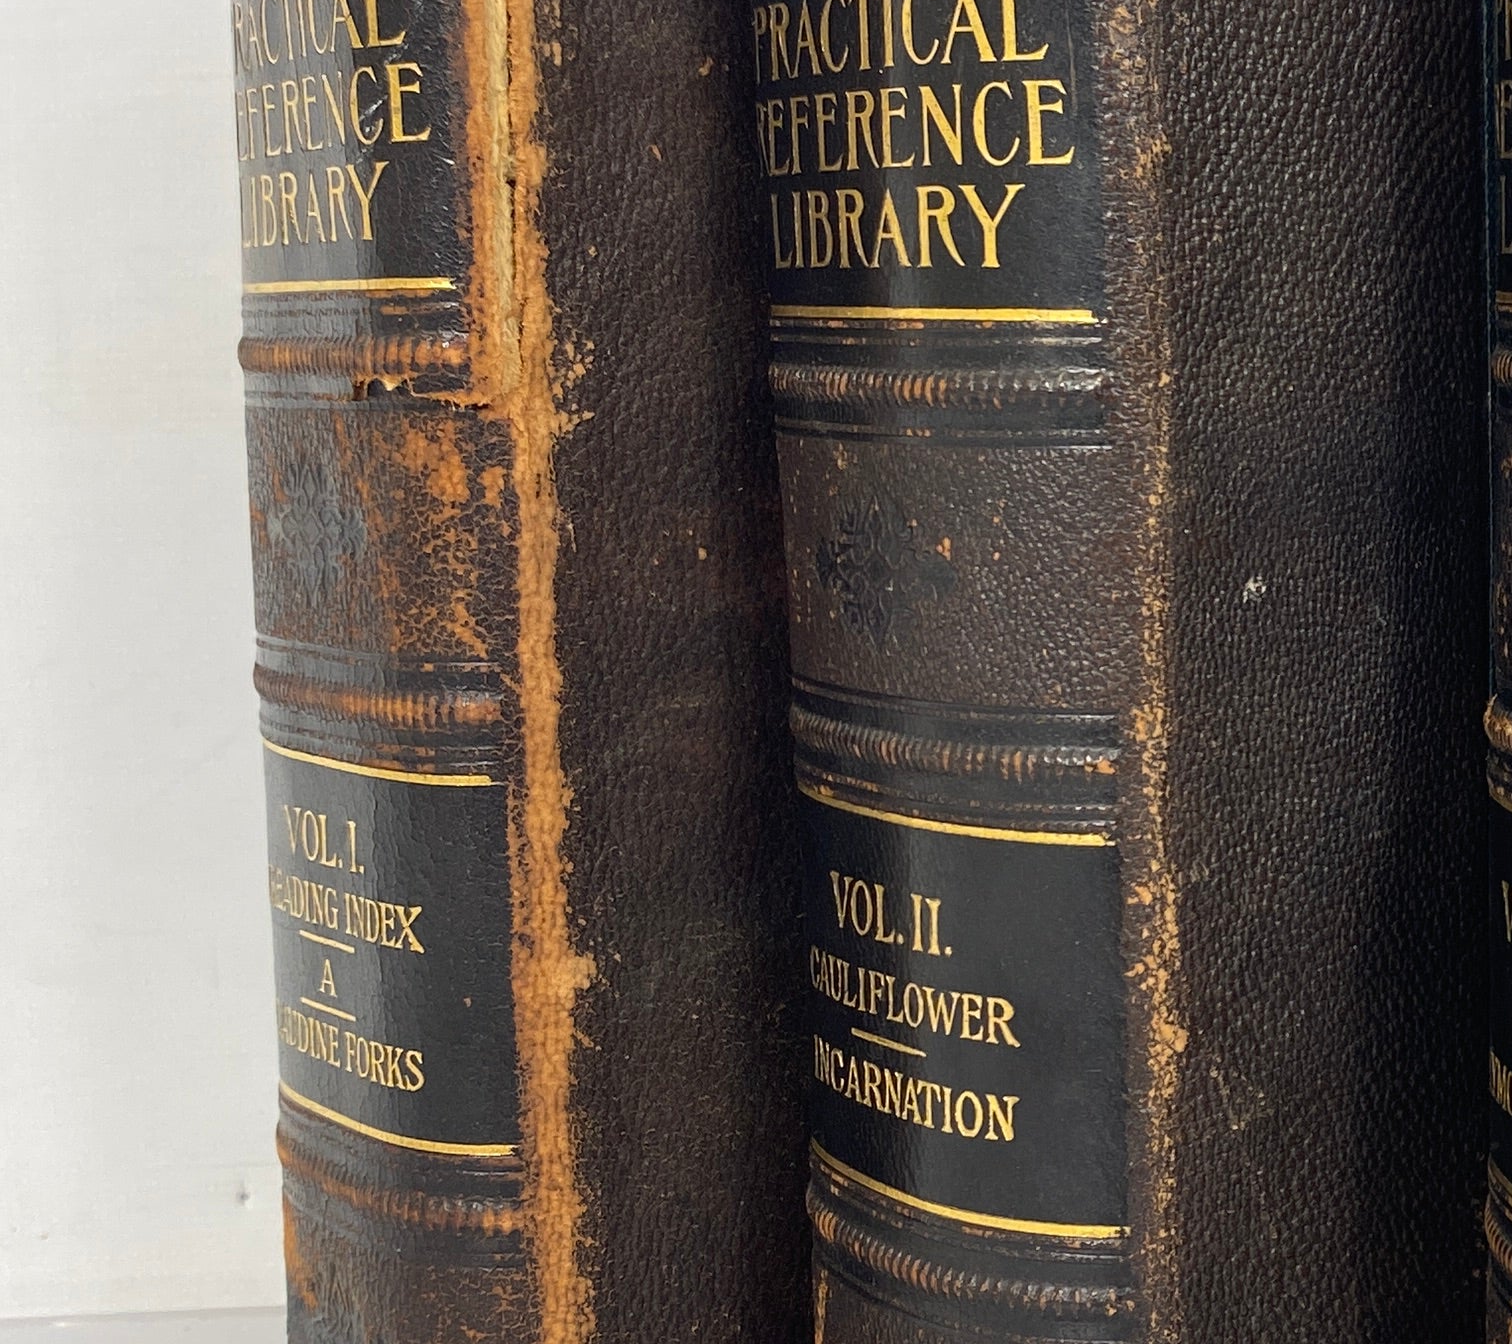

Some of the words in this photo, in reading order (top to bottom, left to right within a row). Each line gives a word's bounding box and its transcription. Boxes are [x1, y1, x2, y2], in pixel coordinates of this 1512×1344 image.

[236, 62, 431, 162] EFERENCE
[755, 79, 1076, 178] REFERENCE
[242, 159, 390, 249] LIBRARY
[771, 183, 1027, 271] LIBRARY
[344, 892, 425, 954] INDEX
[829, 869, 905, 945] VOL.
[319, 958, 338, 998] A
[809, 945, 1022, 1048] CAULIFLOWER
[278, 1003, 341, 1068] AUDINE
[344, 1031, 425, 1092] FORKS
[813, 1033, 1022, 1143] INCARNATION
